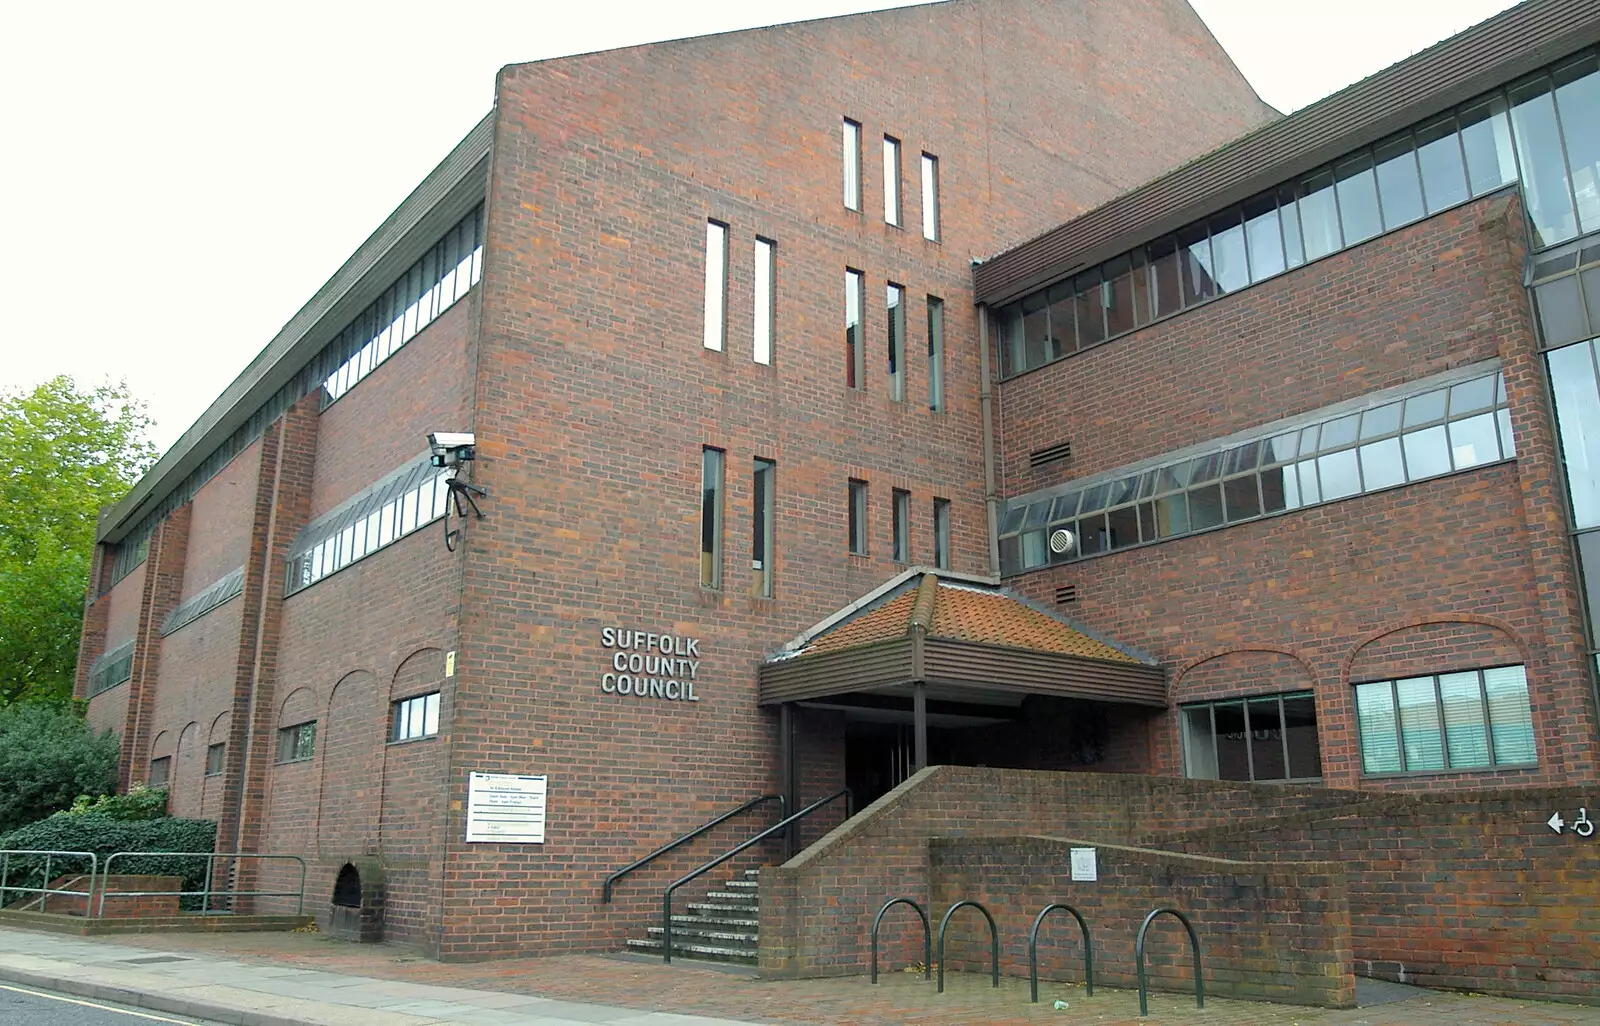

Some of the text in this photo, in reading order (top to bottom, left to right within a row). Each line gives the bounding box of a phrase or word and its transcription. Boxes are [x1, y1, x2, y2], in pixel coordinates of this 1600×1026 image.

[601, 627, 700, 657] SUFFOLK
[613, 651, 700, 679] COUNTY
[601, 672, 700, 701] COUNCIL
